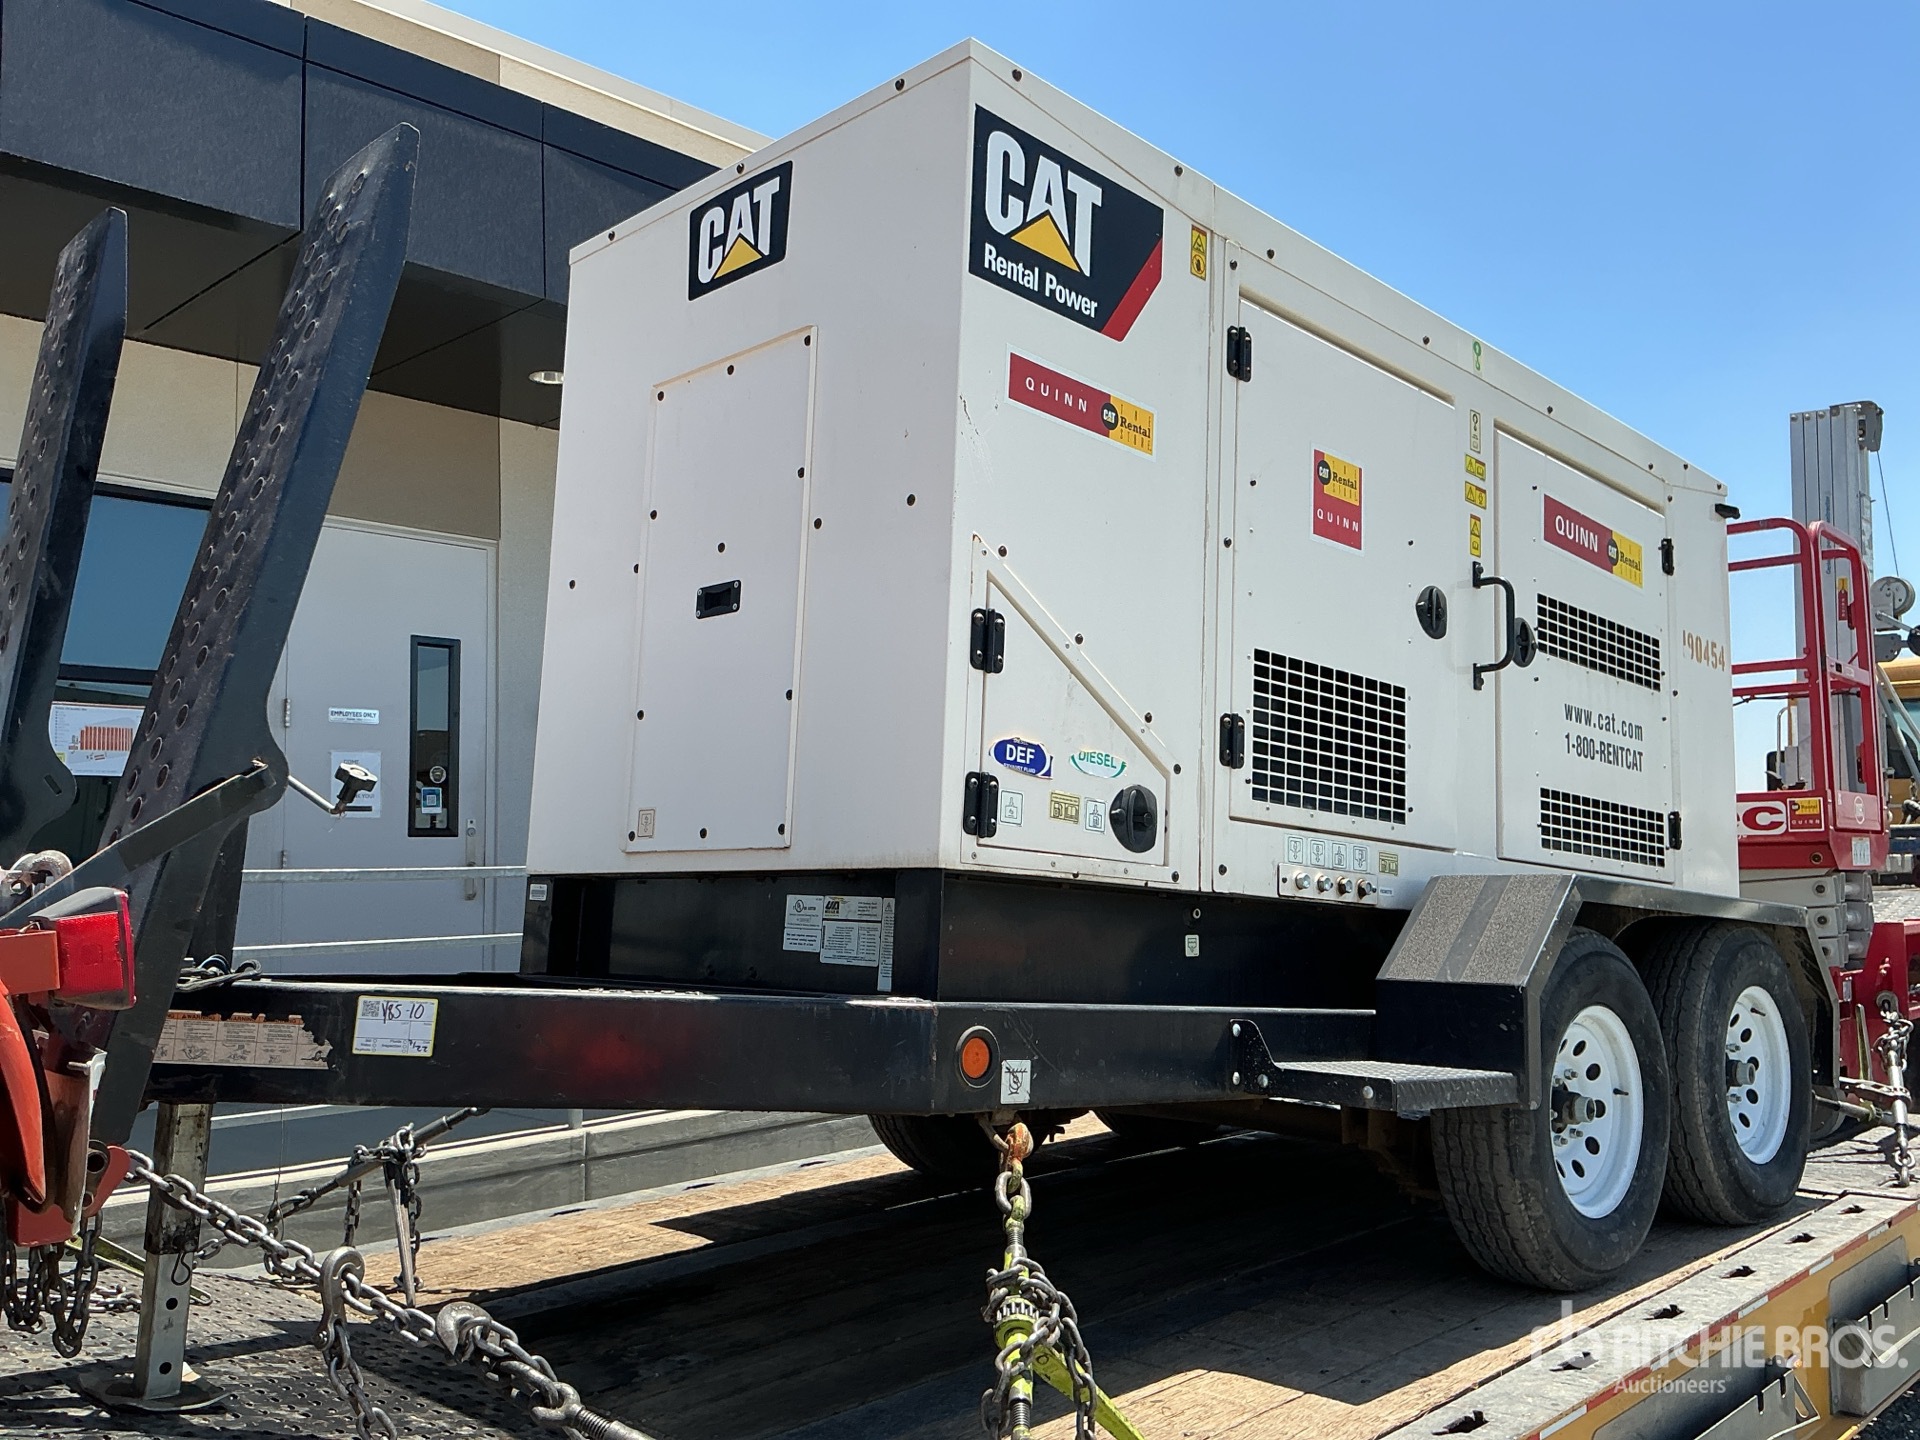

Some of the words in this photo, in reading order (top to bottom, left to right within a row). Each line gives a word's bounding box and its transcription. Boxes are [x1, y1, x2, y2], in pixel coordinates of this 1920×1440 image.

[985, 131, 1102, 277] CAT
[698, 176, 780, 284] CAT
[984, 242, 1039, 292] Rental
[1044, 271, 1098, 318] Power
[1026, 376, 1088, 413] QUINN
[1103, 407, 1116, 423] CAT
[1120, 416, 1151, 438] Rental
[1318, 466, 1330, 479] CAT
[1332, 471, 1358, 490] Rental
[1316, 508, 1359, 532] QUINN
[1555, 514, 1598, 553] QUINN
[1620, 550, 1641, 572] Rental
[330, 710, 362, 718] EMPLOYEES
[1564, 702, 1644, 742] www.cat.com
[1006, 743, 1036, 765] DEF
[1078, 750, 1117, 770] DIESEL
[1564, 732, 1644, 774] 1-800-RENTCAT
[1737, 806, 1784, 830] C
